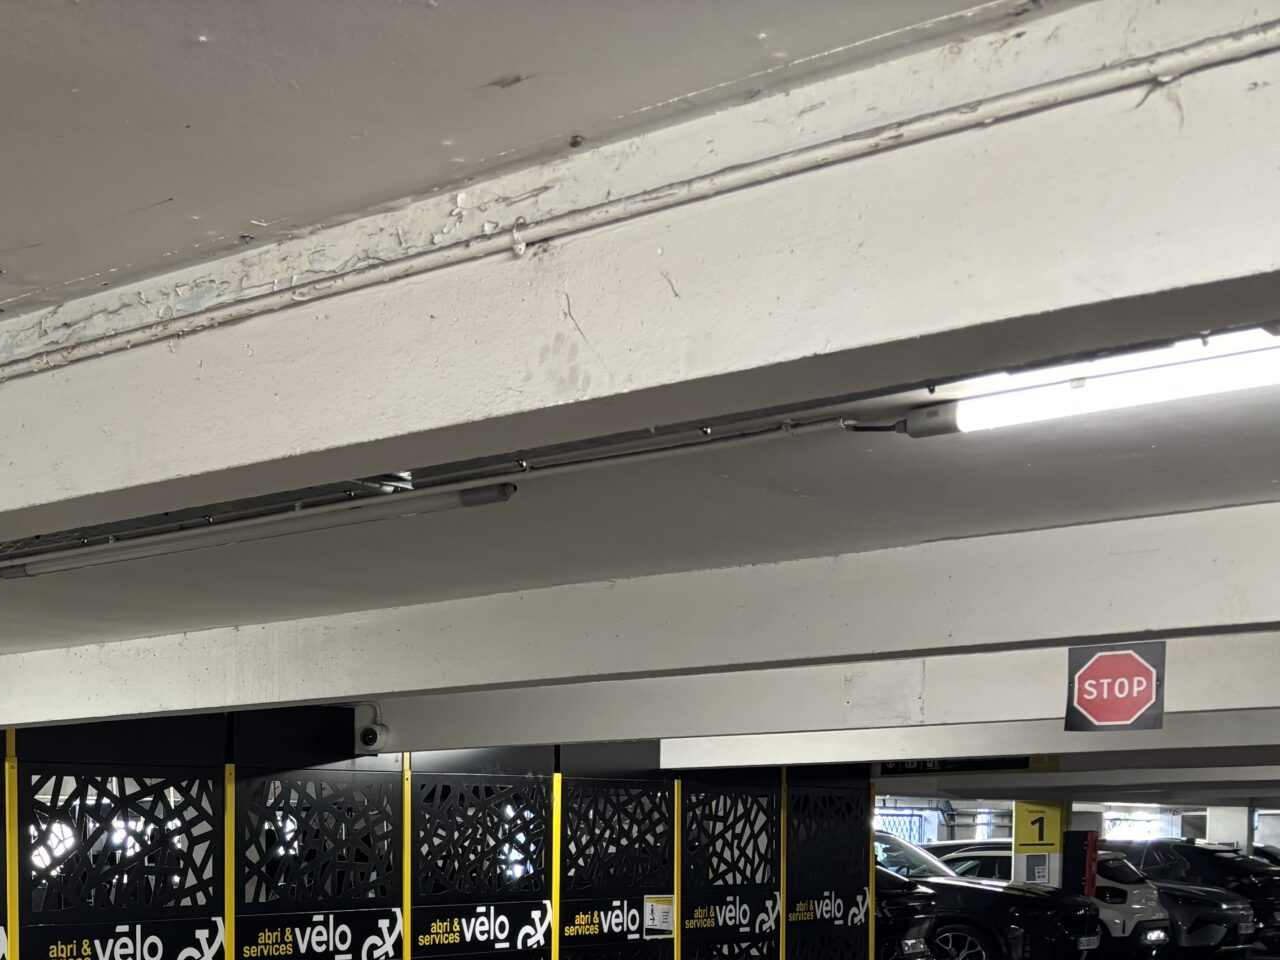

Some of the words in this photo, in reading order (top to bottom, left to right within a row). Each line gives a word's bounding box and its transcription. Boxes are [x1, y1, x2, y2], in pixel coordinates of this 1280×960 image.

[1083, 676, 1148, 700] STOP
[1030, 816, 1045, 842] 1
[574, 911, 591, 926] abri
[592, 911, 600, 924] &
[694, 906, 708, 920] abri
[431, 918, 449, 934] abri
[452, 917, 460, 931] &
[564, 921, 600, 937] services
[685, 916, 715, 929] services
[257, 928, 281, 945] abri
[284, 927, 293, 943] &
[418, 931, 460, 946] services
[48, 940, 77, 959] abri
[81, 939, 92, 956] &
[243, 943, 293, 958] services
